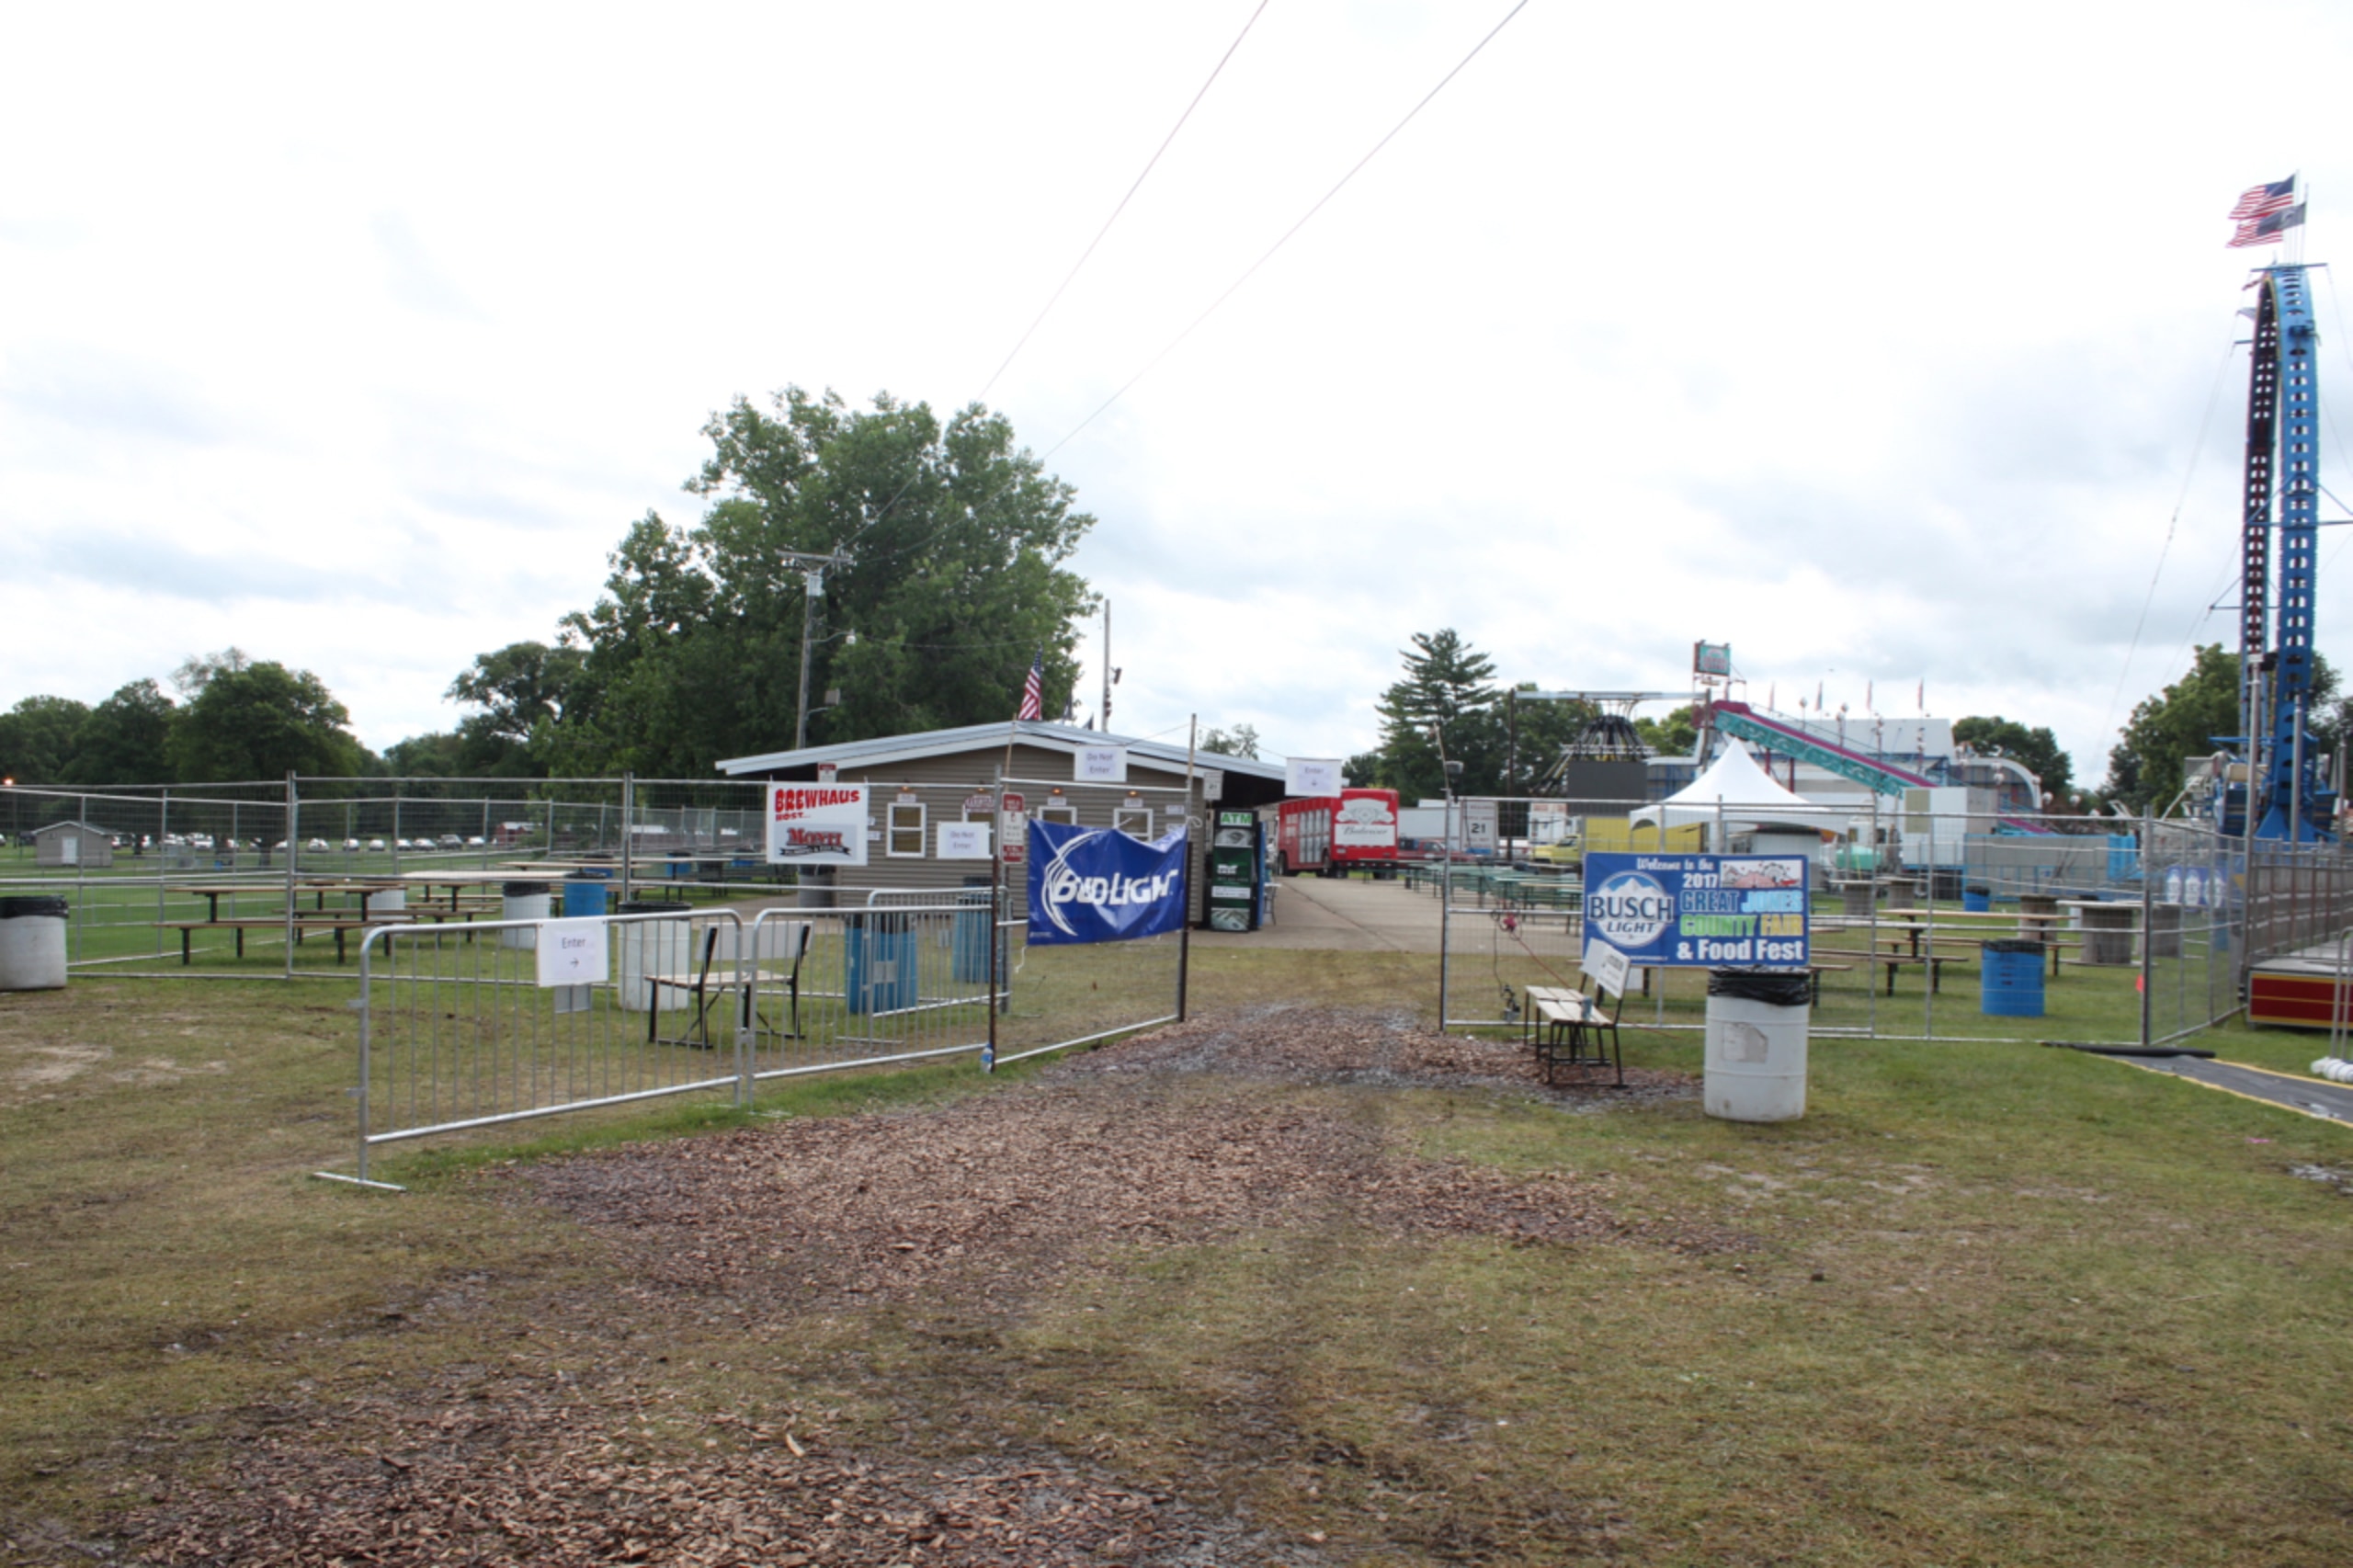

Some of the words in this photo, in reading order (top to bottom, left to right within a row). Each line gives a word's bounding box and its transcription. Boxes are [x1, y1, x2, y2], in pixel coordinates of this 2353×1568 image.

[775, 789, 860, 813] BREWHAUS
[1221, 813, 1252, 825] ATM
[1472, 824, 1486, 834] 21
[1636, 858, 1681, 870] Welcome
[1698, 858, 1714, 870] the
[1682, 873, 1718, 888] 2017
[1589, 895, 1673, 922] BUSCH
[1680, 890, 1739, 913] GREAT
[1741, 891, 1803, 913] JONES
[1606, 922, 1655, 933] LIGHT
[1679, 915, 1756, 937] COUNTY
[1760, 915, 1803, 937] FAIR
[562, 937, 586, 949] Enter
[1677, 941, 1693, 960] &
[1698, 938, 1751, 960] Food
[1756, 939, 1803, 960] Fest
